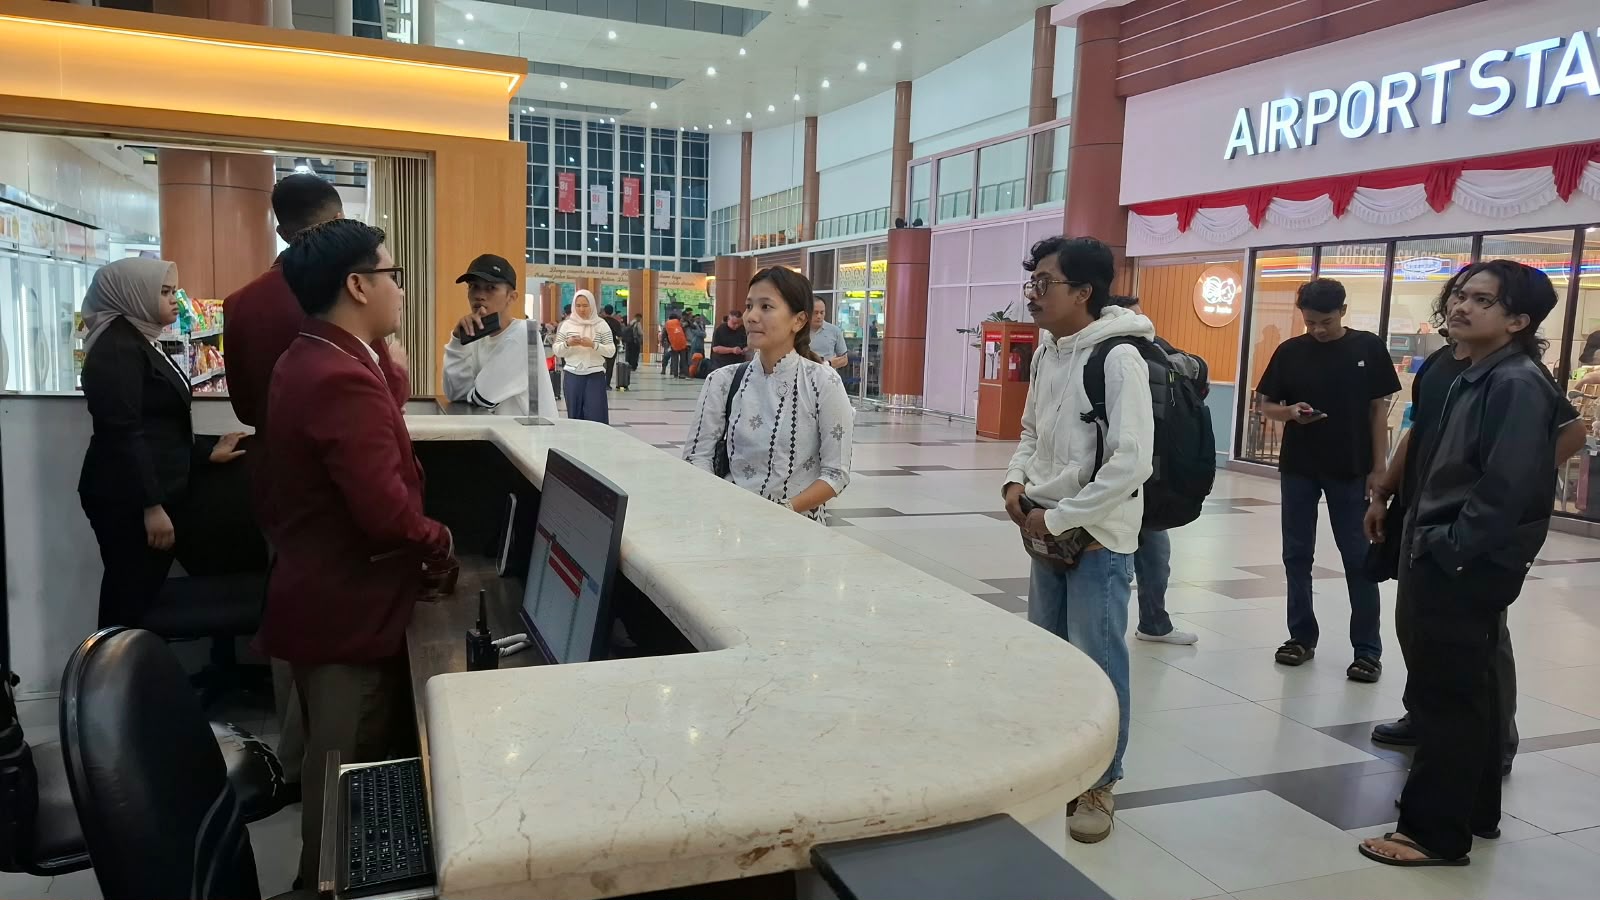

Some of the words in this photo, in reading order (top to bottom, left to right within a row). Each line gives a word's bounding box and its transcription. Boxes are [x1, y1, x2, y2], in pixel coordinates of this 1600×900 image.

[1223, 58, 1465, 160] AIRPORT
[1467, 27, 1600, 117] STA
[1336, 244, 1382, 264] COFFEE
